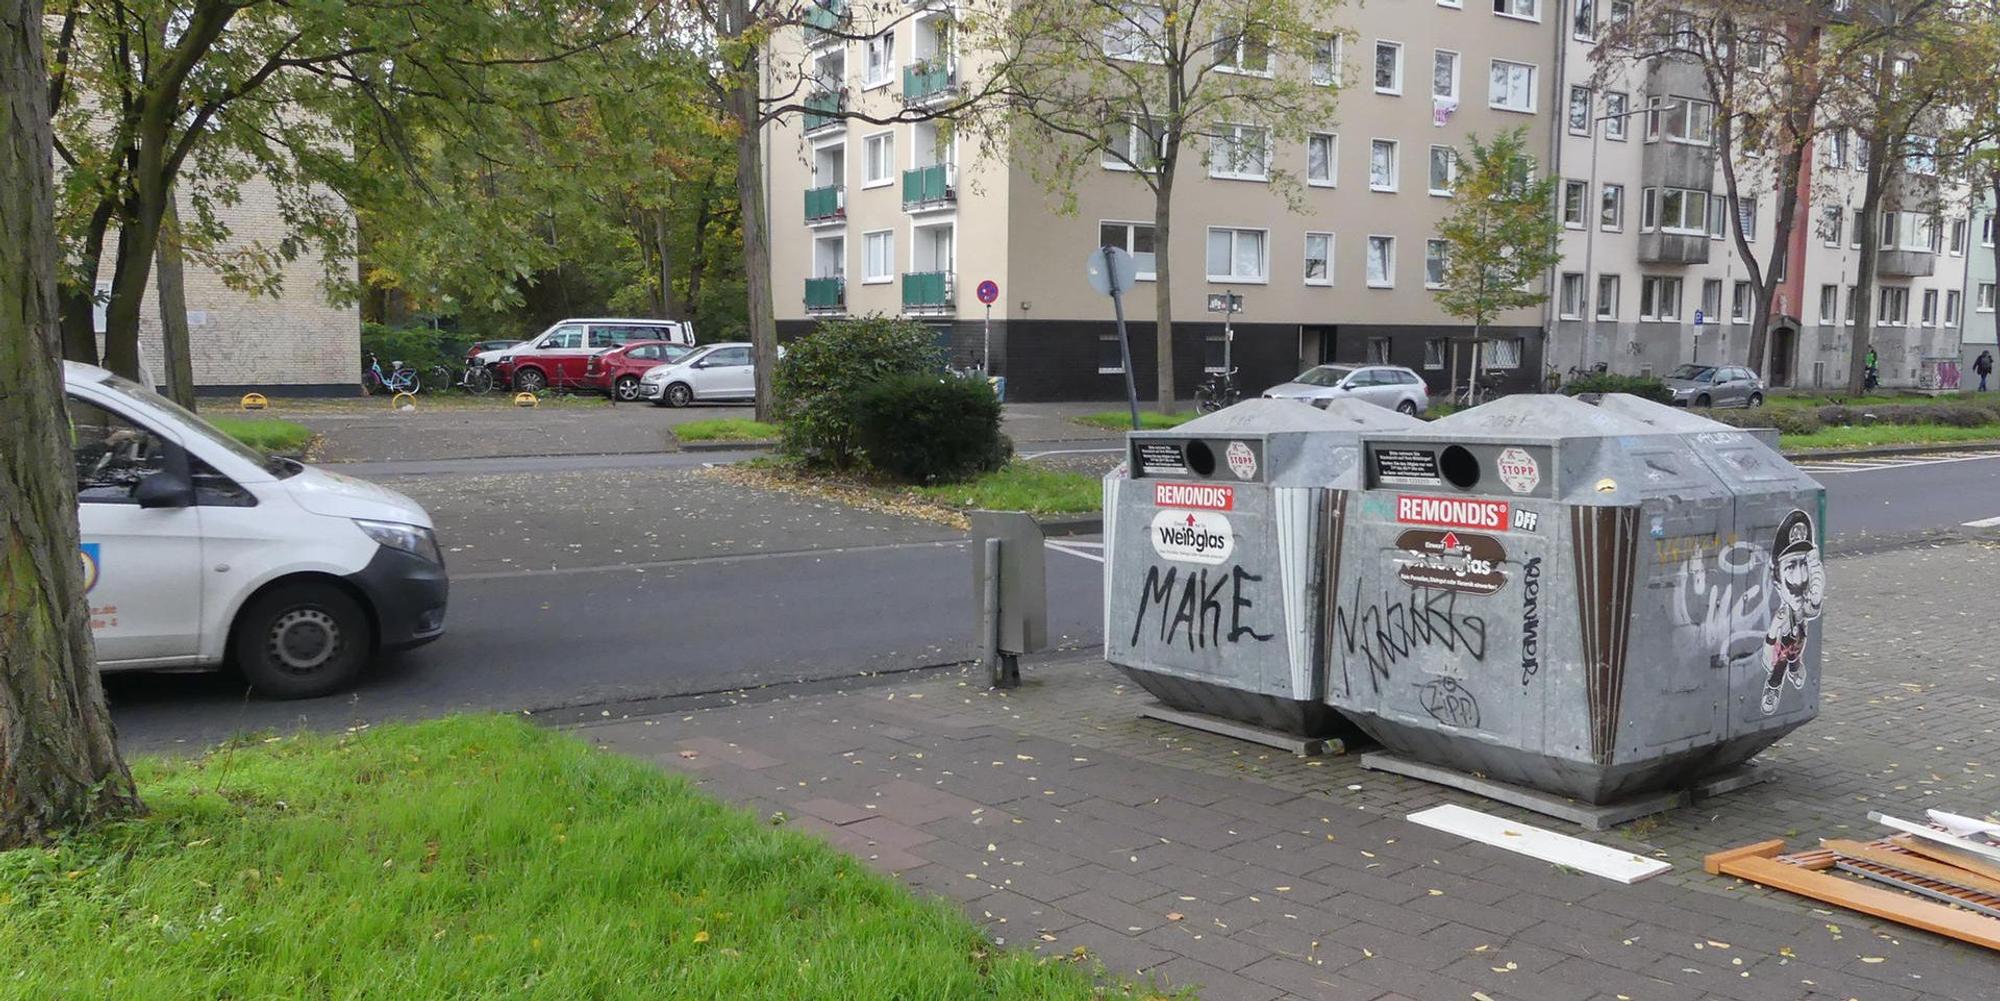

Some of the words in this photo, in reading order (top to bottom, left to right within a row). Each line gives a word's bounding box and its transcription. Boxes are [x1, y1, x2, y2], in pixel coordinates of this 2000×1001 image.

[1230, 455, 1253, 465] STOPP
[1502, 465, 1534, 476] STOPP
[1514, 509, 1537, 530] DFF
[1159, 526, 1225, 552] Weißglas
[1131, 564, 1275, 653] MAKE
